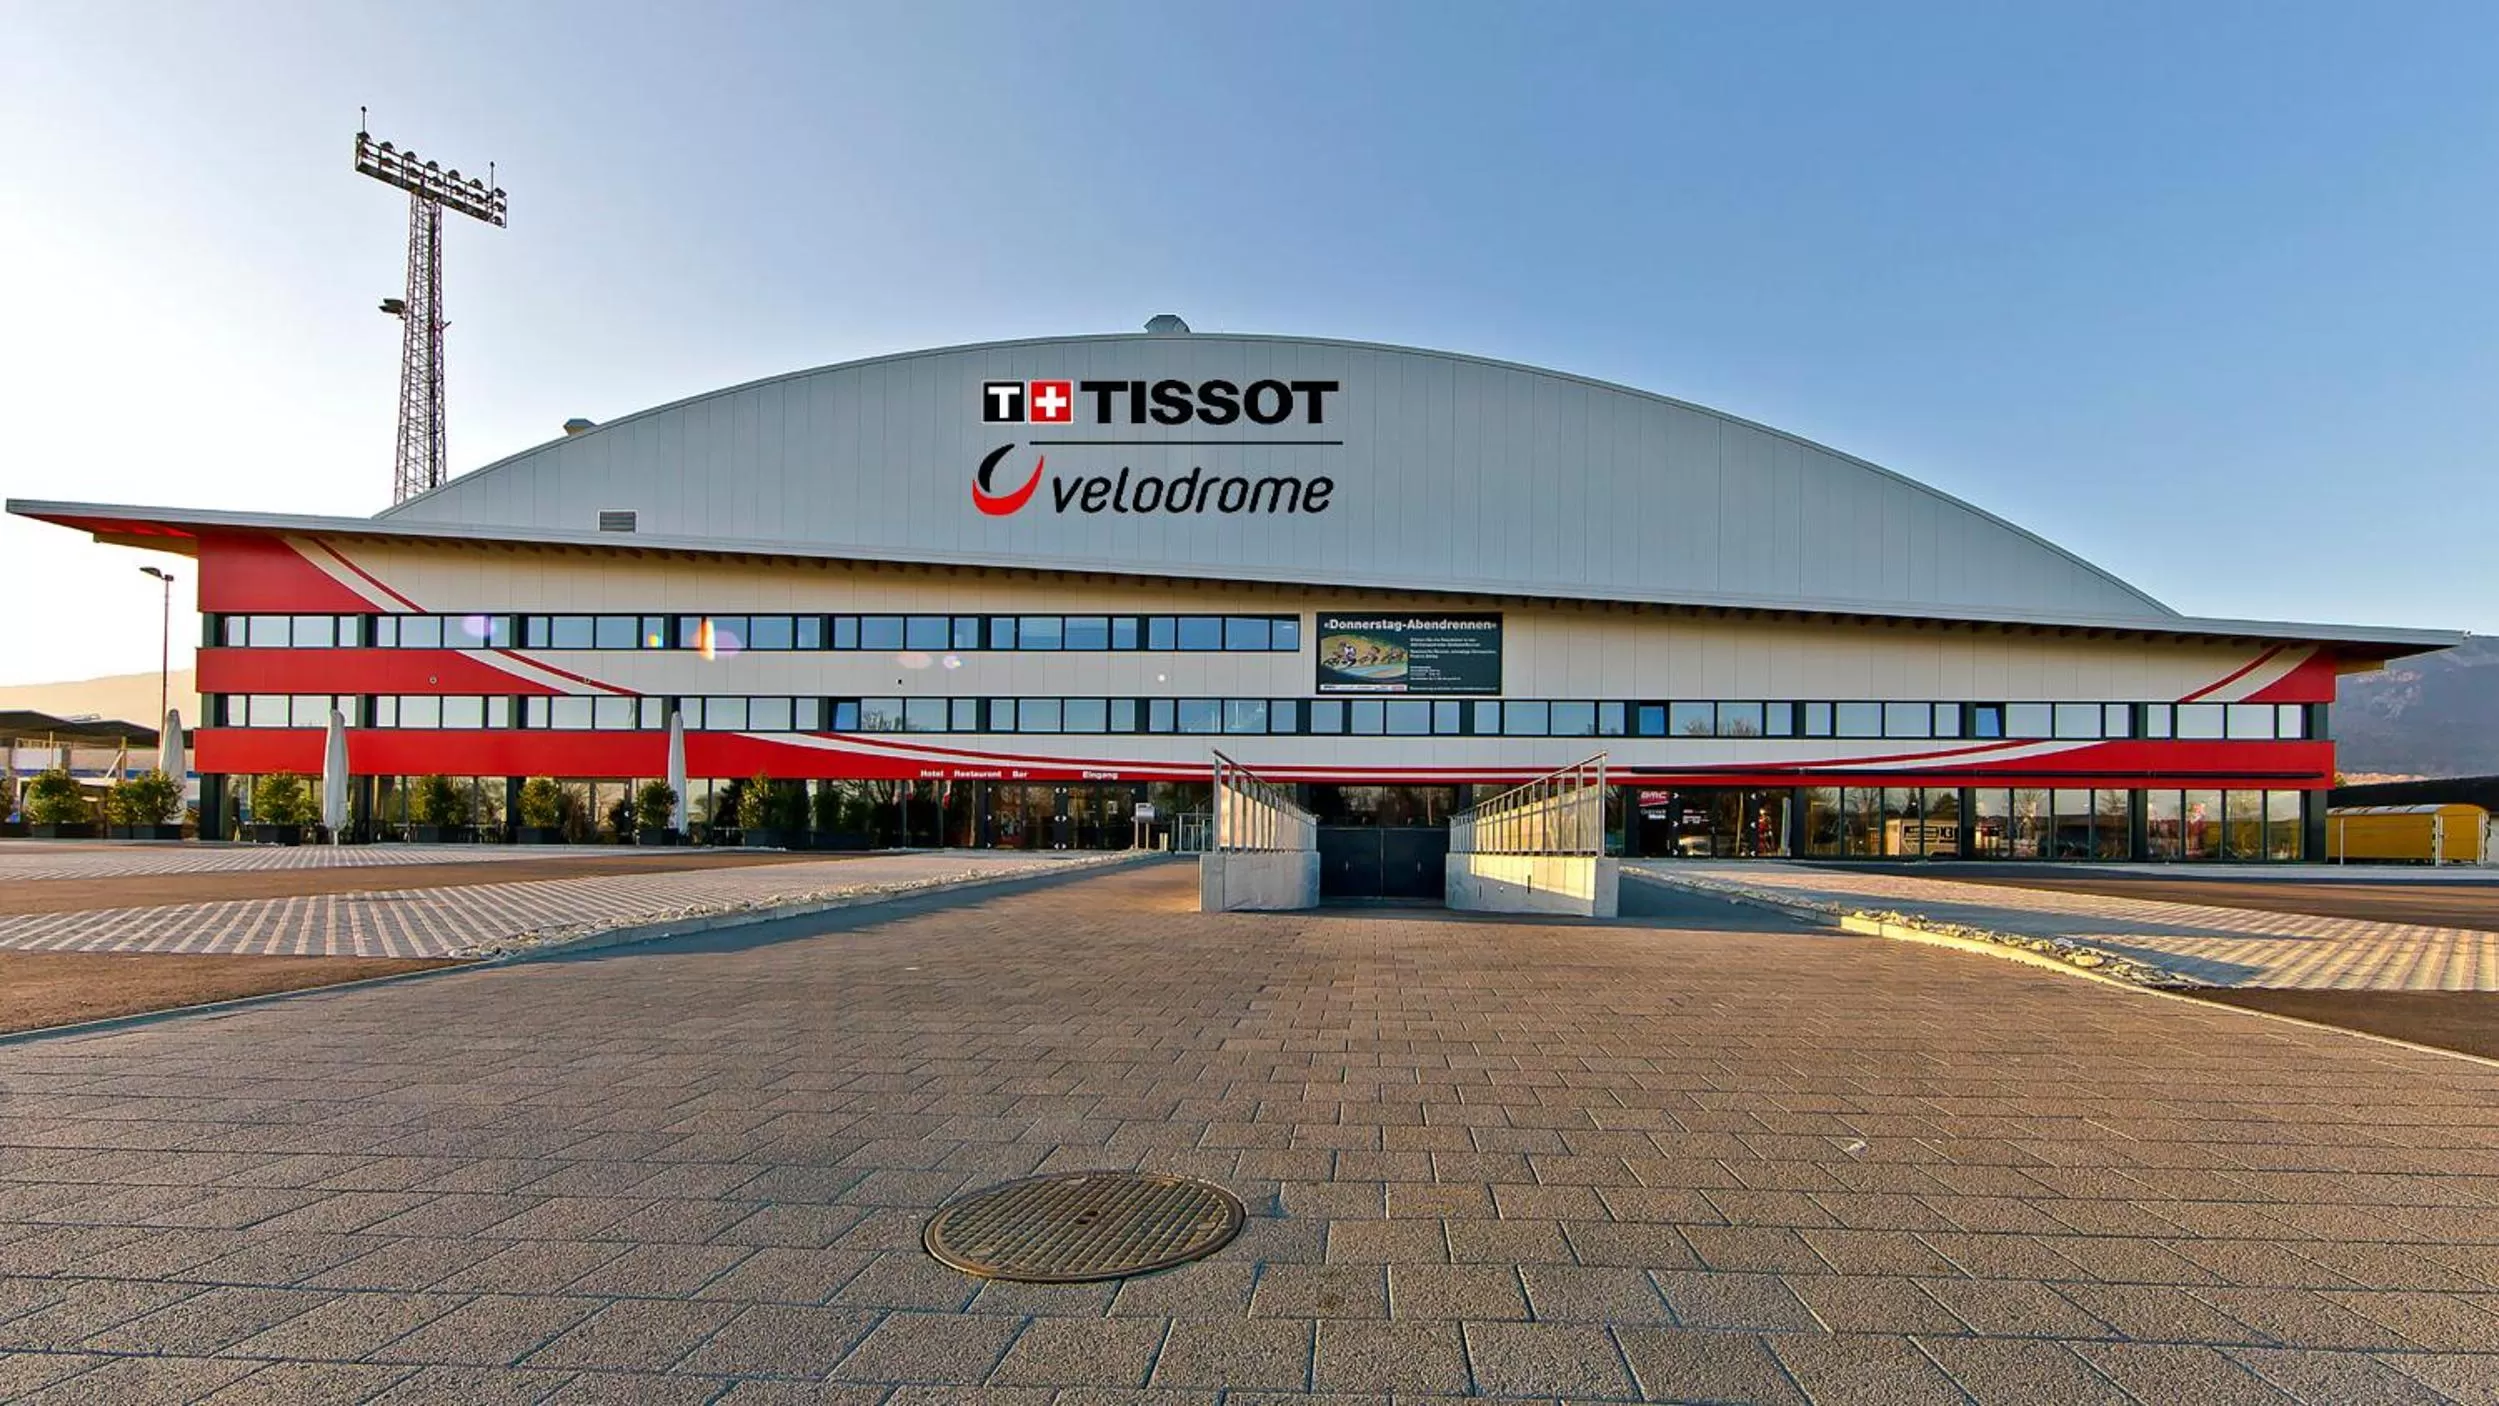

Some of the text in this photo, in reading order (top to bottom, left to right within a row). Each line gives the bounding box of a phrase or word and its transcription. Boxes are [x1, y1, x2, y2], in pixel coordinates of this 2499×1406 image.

[1080, 379, 1339, 425] TISSOT
[1052, 466, 1335, 514] velodrome
[920, 770, 1028, 778] Hotel Restaurant Bar
[1082, 770, 1119, 780] Eingang
